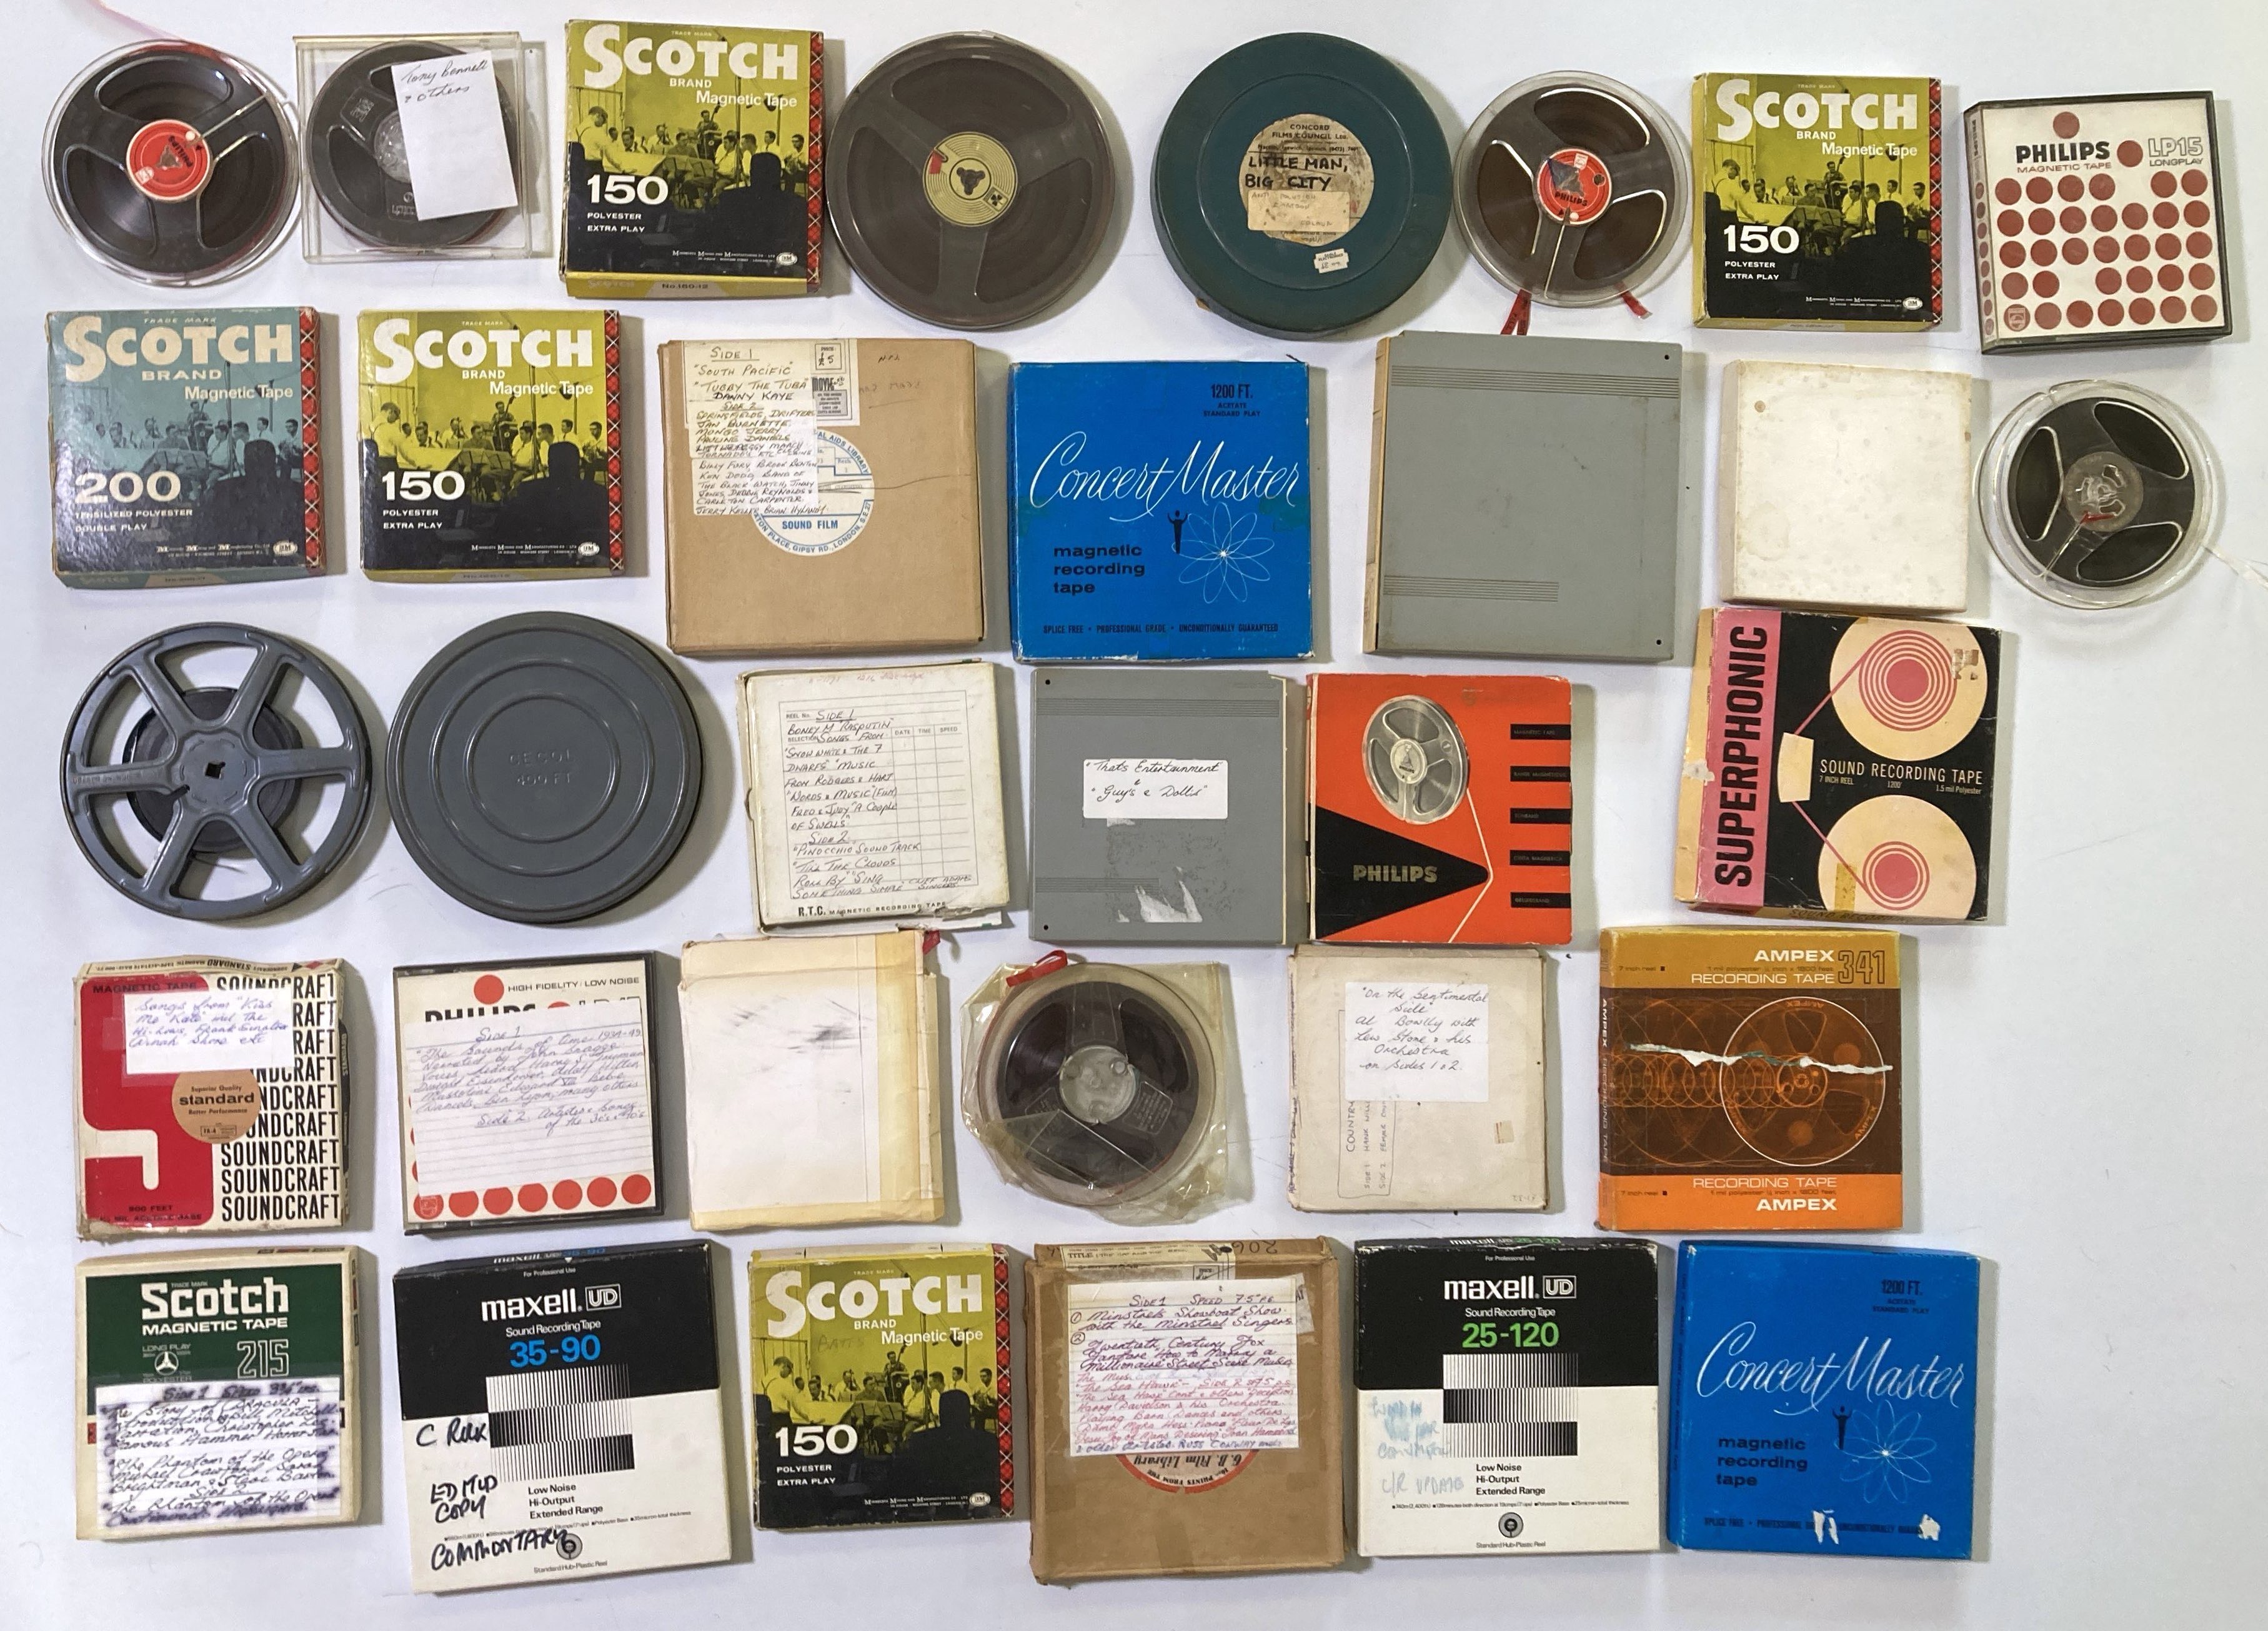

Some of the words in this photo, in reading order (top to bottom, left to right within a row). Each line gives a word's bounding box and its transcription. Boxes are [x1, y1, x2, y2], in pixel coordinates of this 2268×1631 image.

[583, 24, 798, 88] SCOTCH
[402, 64, 437, 85] Tony
[670, 79, 712, 87] BRAND
[696, 91, 762, 107] Magnetic
[764, 93, 797, 107] Tape
[1716, 79, 1917, 142] SCOTCH
[1797, 131, 1836, 140] BRAND
[1822, 142, 1883, 157] Magnetic
[1886, 143, 1917, 157] Tape
[2016, 141, 2110, 163] PHILIPS
[2148, 137, 2203, 158] LP15
[1249, 157, 1298, 169] LITTLE
[1305, 157, 1348, 172] MAN,
[2017, 164, 2080, 173] MAGNETIC
[2149, 158, 2204, 166] LONGPLAY
[587, 175, 668, 205] 150
[1245, 174, 1273, 188] BIG
[1288, 177, 1331, 191] CITY
[1555, 192, 1588, 206] PHILIPS
[1724, 225, 1799, 253] 150
[63, 316, 292, 382] SCOTCH
[374, 318, 593, 385] SCOTCH
[710, 346, 740, 359] SIDE
[142, 370, 222, 381] BRAND
[462, 370, 505, 379] BRAND
[184, 386, 254, 401] Magnetic
[257, 384, 293, 401] Tape
[490, 382, 557, 397] Magnetic
[560, 381, 593, 397] Tape
[749, 381, 770, 389] THE
[1211, 384, 1235, 399] 1200
[1237, 384, 1253, 399] FT.
[714, 392, 755, 400] DANNY
[762, 391, 794, 401] KAYE
[829, 434, 846, 447] AIDS
[848, 446, 869, 474] LIBRARY
[1030, 431, 1175, 522] Concert
[1175, 440, 1300, 507] Master
[75, 471, 181, 504] 200
[382, 471, 465, 501] 150
[76, 524, 116, 532] DOUBLE
[121, 523, 147, 531] PLAY
[782, 520, 812, 529] SOUND
[817, 520, 838, 529] FILM
[1054, 544, 1141, 560] magnetic
[1054, 562, 1145, 576] recording
[1054, 582, 1095, 596] tape
[1043, 625, 1066, 634] SPLICE
[1068, 625, 1083, 634] FREE
[1097, 624, 1142, 634] PROFESSIONAL
[1146, 624, 1166, 633] GRADE
[1238, 623, 1278, 632] GUARANTEED
[817, 710, 843, 721] SIDE
[1714, 626, 1768, 887] SUPERPHONIC
[1819, 759, 1865, 776] SOUND
[1871, 762, 1946, 782] RECORDING
[1952, 769, 1983, 785] TAPE
[1824, 776, 1839, 784] INCH
[1841, 776, 1854, 785] REEL
[1946, 785, 1954, 793] mil
[1956, 786, 1982, 795] Polyester
[1353, 865, 1437, 882] PHILIPS
[830, 907, 871, 915] MAGNETIC
[1754, 950, 1835, 962] AMPEX
[1838, 950, 1886, 984] 341
[1691, 974, 1787, 984] RECORDING
[1795, 973, 1835, 984] TAPE
[92, 983, 161, 994] MAGNETIC
[167, 982, 197, 990] TAPE
[508, 984, 532, 992] HIGH
[536, 982, 579, 990] FIDELITY
[179, 1091, 254, 1105] standard
[1346, 1102, 1355, 1152] COUNTRY
[221, 1140, 339, 1167] SOUNDCRAFT
[222, 1166, 340, 1194] SOUNDCRAFT
[1693, 1177, 1789, 1189] RECORDING
[1797, 1177, 1837, 1188] TAPE
[222, 1194, 340, 1222] SOUNDCRAFT
[1756, 1198, 1837, 1211] AMPEX
[1444, 1275, 1534, 1300] maxell
[1545, 1278, 1573, 1296] UD
[1881, 1279, 1903, 1295] 1200
[1907, 1280, 1923, 1295] FT.
[141, 1277, 289, 1320] Scotch
[481, 1289, 577, 1322] maxell
[588, 1287, 618, 1307] UD
[765, 1270, 983, 1339] SCOTCH
[1465, 1307, 1493, 1317] Sound
[1494, 1307, 1536, 1319] Recording
[1536, 1308, 1555, 1318] Tape
[142, 1320, 237, 1336] MAGNETIC
[242, 1317, 288, 1330] TAPE
[505, 1324, 535, 1337] Sound
[536, 1321, 580, 1335] Recording
[580, 1319, 601, 1332] Tape
[854, 1319, 897, 1330] BRAND
[882, 1330, 948, 1345] Magnetic
[950, 1327, 983, 1344] Tape
[1461, 1322, 1559, 1349] 25-120
[142, 1344, 168, 1352] LONG
[170, 1342, 191, 1351] PLAY
[509, 1334, 601, 1369] 35-90
[237, 1339, 289, 1379] 215
[1696, 1321, 1841, 1416] Concert
[1841, 1336, 1965, 1409] Master
[775, 1424, 858, 1457] 150
[1718, 1437, 1806, 1452] magnetic
[777, 1464, 832, 1473] POLYESTER
[1476, 1463, 1495, 1472] Low
[1496, 1464, 1522, 1472] Noise
[1718, 1456, 1808, 1471] recording
[812, 1477, 836, 1485] PLAY
[1476, 1475, 1519, 1485] Hi-Output
[1716, 1473, 1758, 1487] tape
[528, 1485, 548, 1495] Low
[549, 1483, 577, 1492] Noise
[1476, 1487, 1517, 1495] Extended
[1519, 1487, 1545, 1496] Range
[529, 1495, 575, 1507] Hi-Output
[529, 1507, 574, 1519] Extended
[575, 1505, 604, 1516] Range
